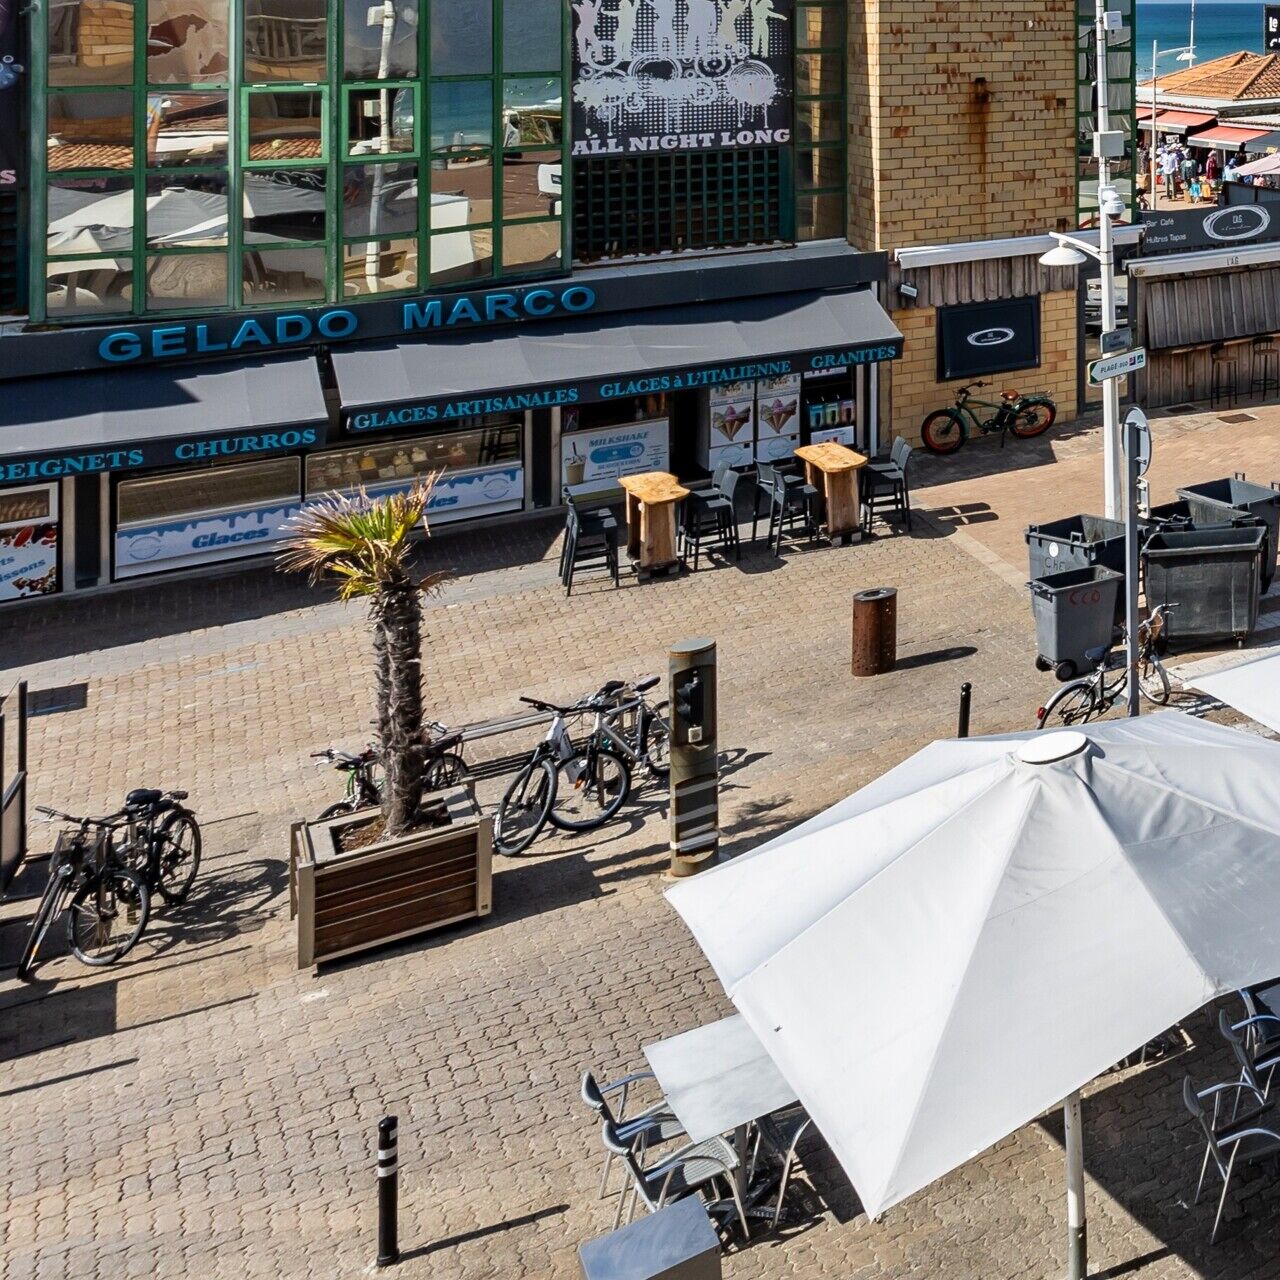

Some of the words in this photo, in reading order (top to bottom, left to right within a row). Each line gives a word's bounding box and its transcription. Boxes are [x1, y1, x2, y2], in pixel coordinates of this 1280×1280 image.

[1268, 16, 1278, 32] Le
[571, 138, 624, 156] ALL
[628, 132, 715, 152] NIGHT
[720, 128, 791, 147] LONG
[1160, 217, 1175, 227] Café
[1169, 232, 1187, 243] Tapas
[98, 309, 359, 362] GELADO
[402, 285, 597, 331] MARCO
[1100, 362, 1118, 374] PLAGE
[353, 405, 438, 430] GLACES
[441, 387, 580, 419] ARTISANALES
[599, 375, 671, 398] GLACES
[674, 373, 683, 388] à
[686, 359, 792, 387] L'ITALIENNE
[810, 344, 897, 370] GRANITÉS
[174, 428, 317, 460] CHURROS
[588, 430, 651, 448] MILKSHAKE
[191, 526, 270, 549] Glaces
